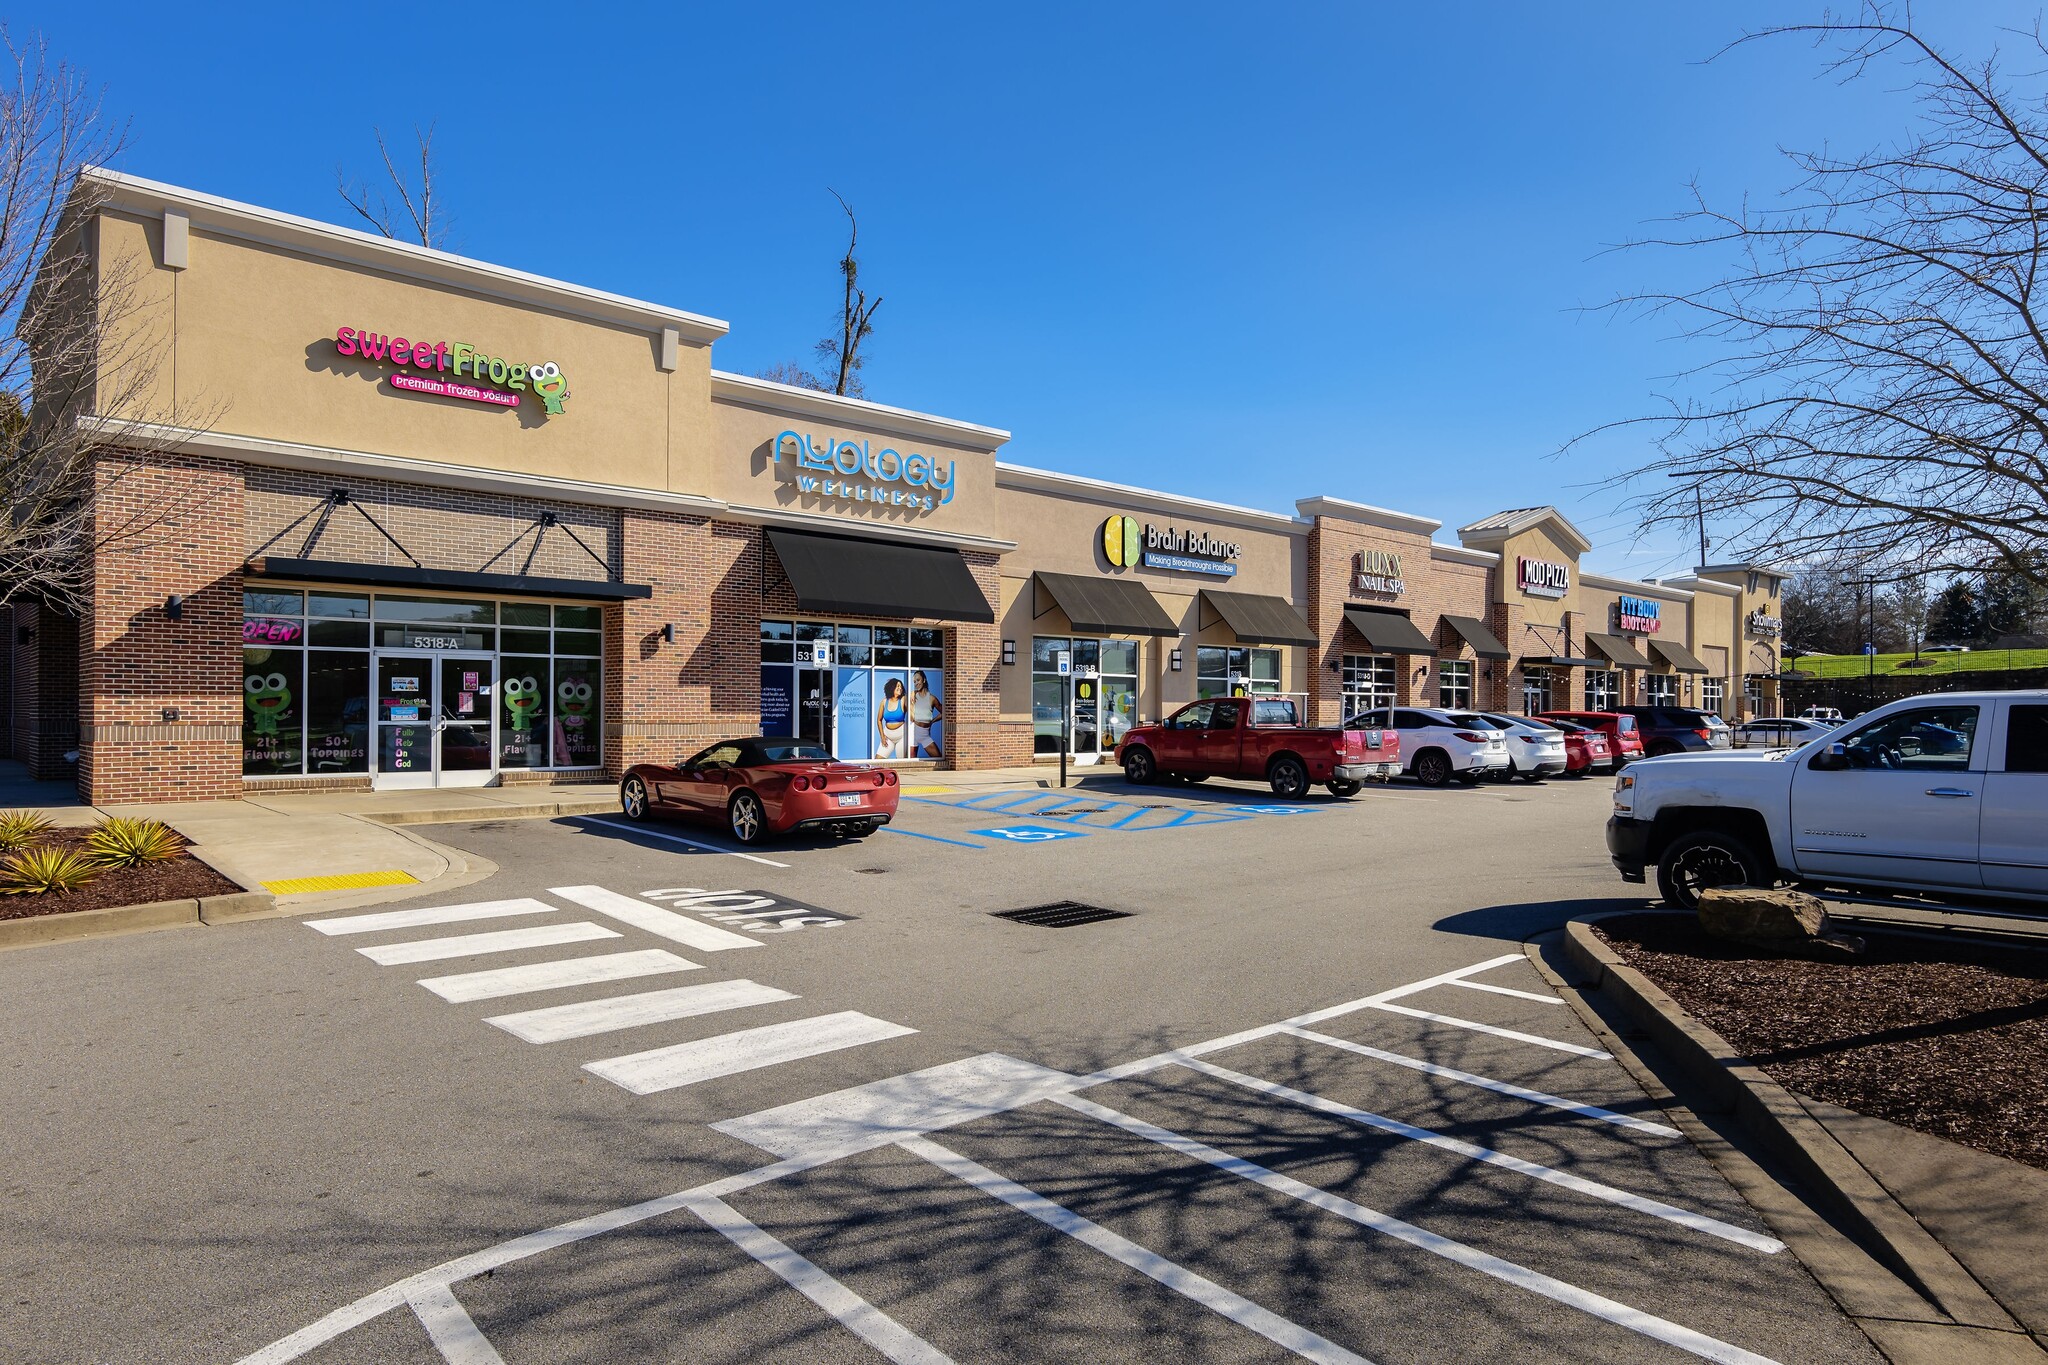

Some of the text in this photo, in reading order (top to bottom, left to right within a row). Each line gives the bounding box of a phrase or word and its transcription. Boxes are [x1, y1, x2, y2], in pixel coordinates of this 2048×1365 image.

[396, 376, 516, 405] premium frozen yogurt
[796, 475, 934, 511] WELLNESS
[1147, 523, 1243, 560] Brain Balance
[1149, 554, 1234, 573] Making Breakthroughs Possible
[1525, 559, 1570, 589] MOD PIZZA
[1360, 574, 1406, 594] NAIL SPA
[1621, 595, 1661, 619] FIT BODY
[243, 623, 295, 642] OPEN
[414, 637, 459, 649] 5318-A
[841, 705, 866, 713] Happiness
[395, 728, 414, 737] Fully
[256, 737, 279, 748] 21+
[325, 736, 350, 747] 50+
[395, 738, 413, 747] Rely
[514, 734, 531, 743] 21+
[566, 734, 585, 743] 50+
[244, 750, 292, 760] Flavors
[311, 747, 364, 758] Toppings
[395, 749, 408, 758] On
[395, 759, 412, 768] God
